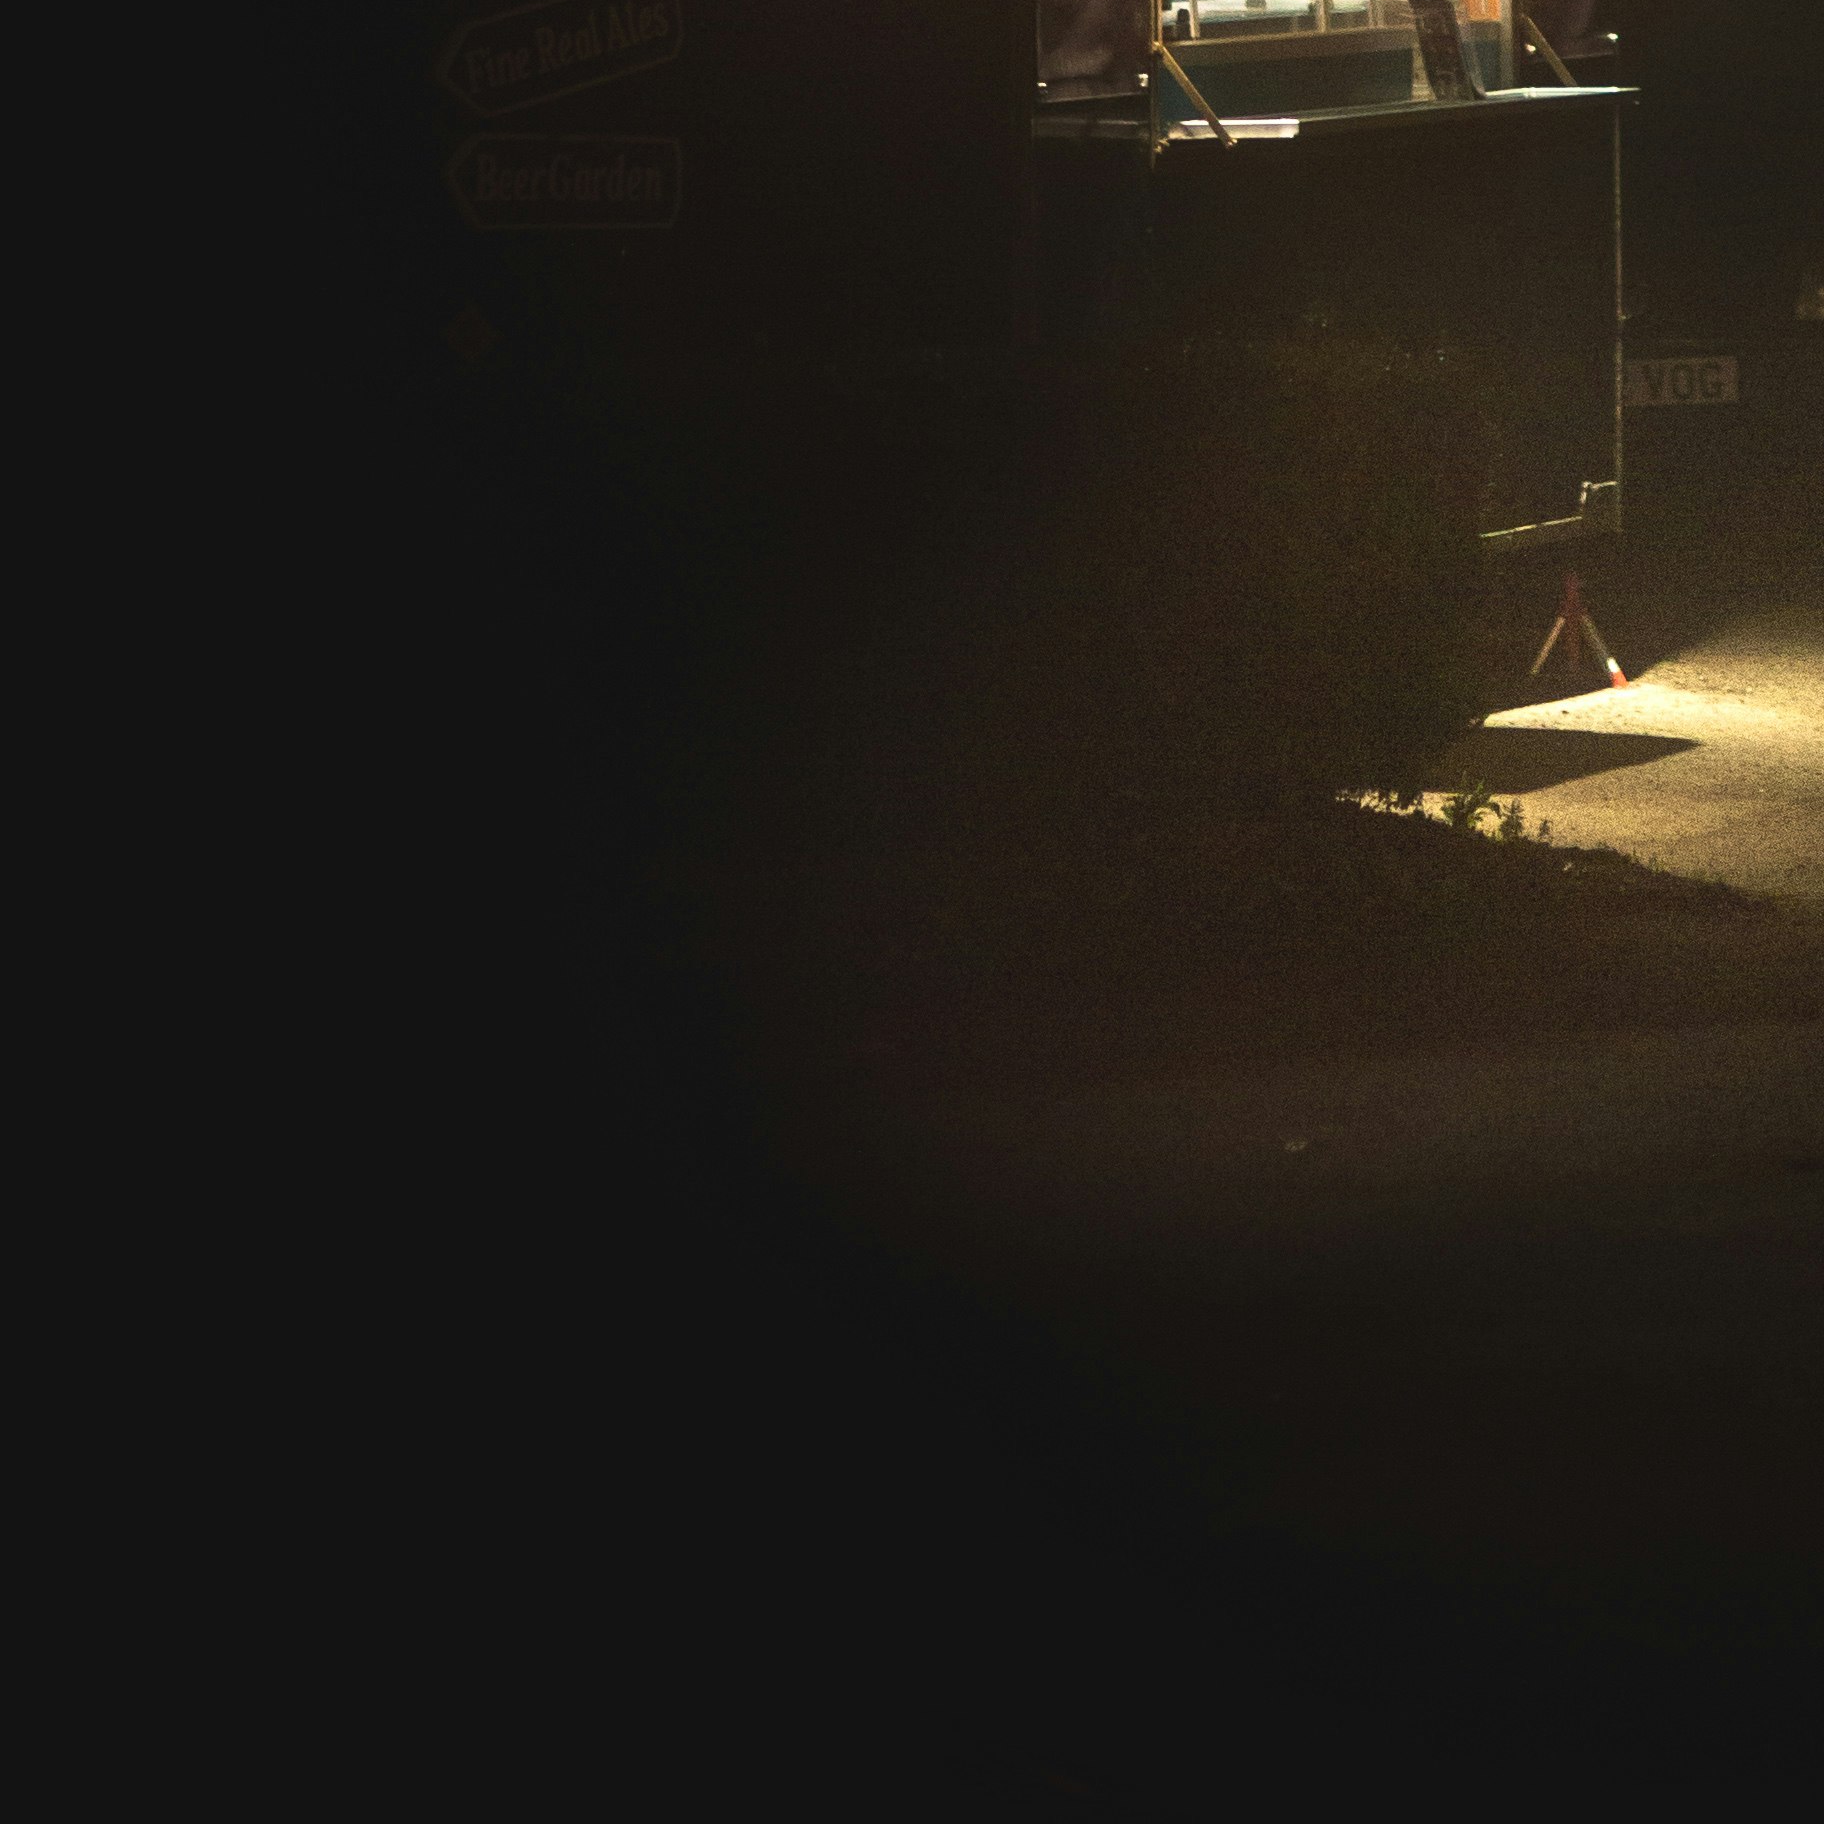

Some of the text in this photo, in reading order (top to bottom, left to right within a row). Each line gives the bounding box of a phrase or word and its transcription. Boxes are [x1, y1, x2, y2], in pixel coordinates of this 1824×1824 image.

[465, 0, 670, 95] Fine Real Ales
